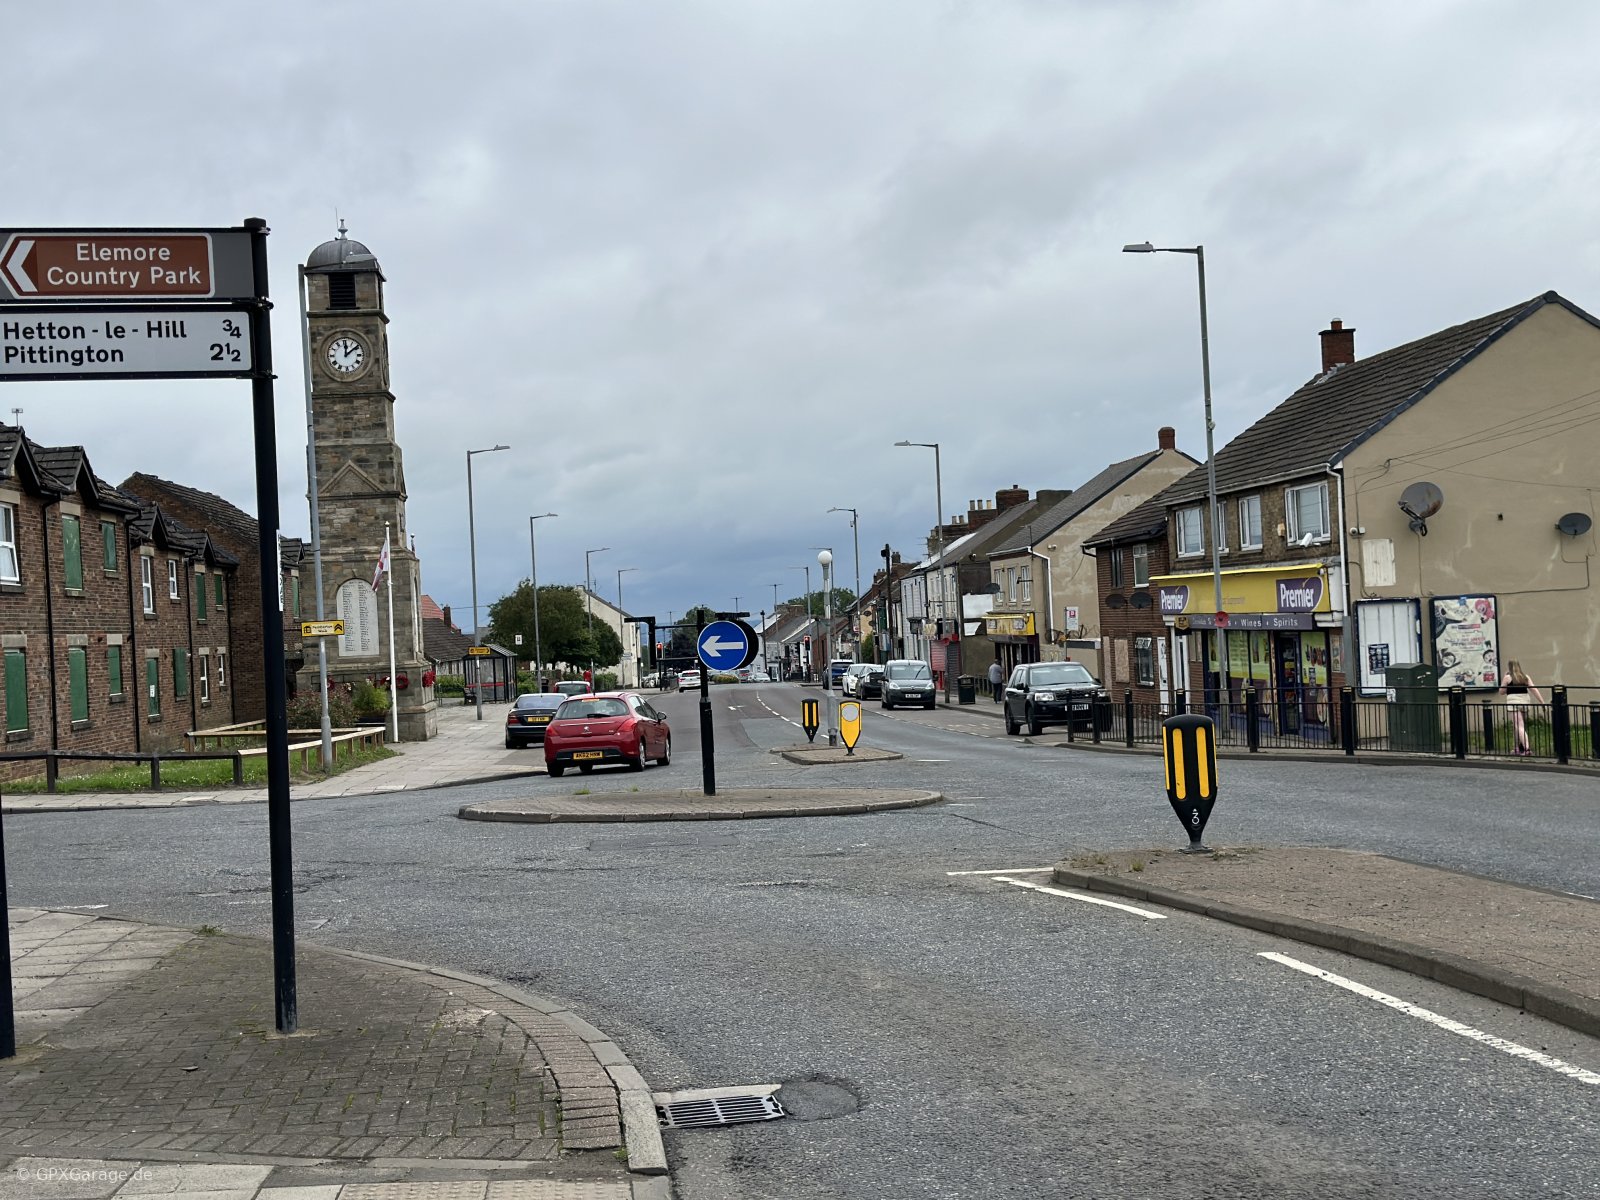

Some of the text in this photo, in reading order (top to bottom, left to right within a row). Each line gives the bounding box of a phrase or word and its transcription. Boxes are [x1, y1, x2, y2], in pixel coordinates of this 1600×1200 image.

[76, 243, 171, 261] Elemore
[47, 266, 202, 288] Country Park
[3, 322, 86, 340] Hetton
[105, 321, 126, 339] le
[147, 320, 187, 338] Hill
[5, 345, 124, 366] Pittington
[1161, 590, 1184, 611] Premier
[1280, 583, 1314, 608] Premier
[1240, 619, 1262, 628] Wines
[1273, 617, 1298, 628] Spirits
